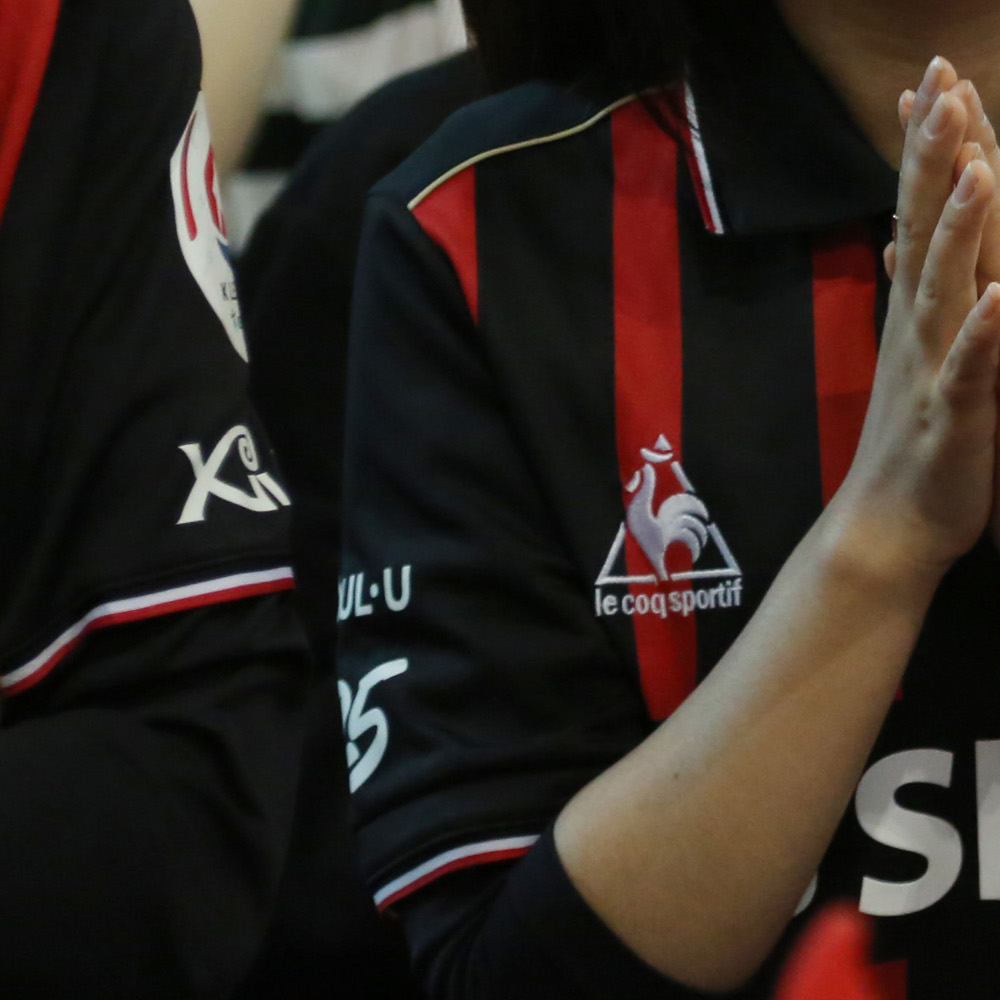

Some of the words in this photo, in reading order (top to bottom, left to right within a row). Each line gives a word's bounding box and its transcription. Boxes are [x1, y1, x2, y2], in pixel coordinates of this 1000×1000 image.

[594, 588, 617, 617] le
[621, 594, 667, 619] coq
[668, 577, 742, 617] sportif
